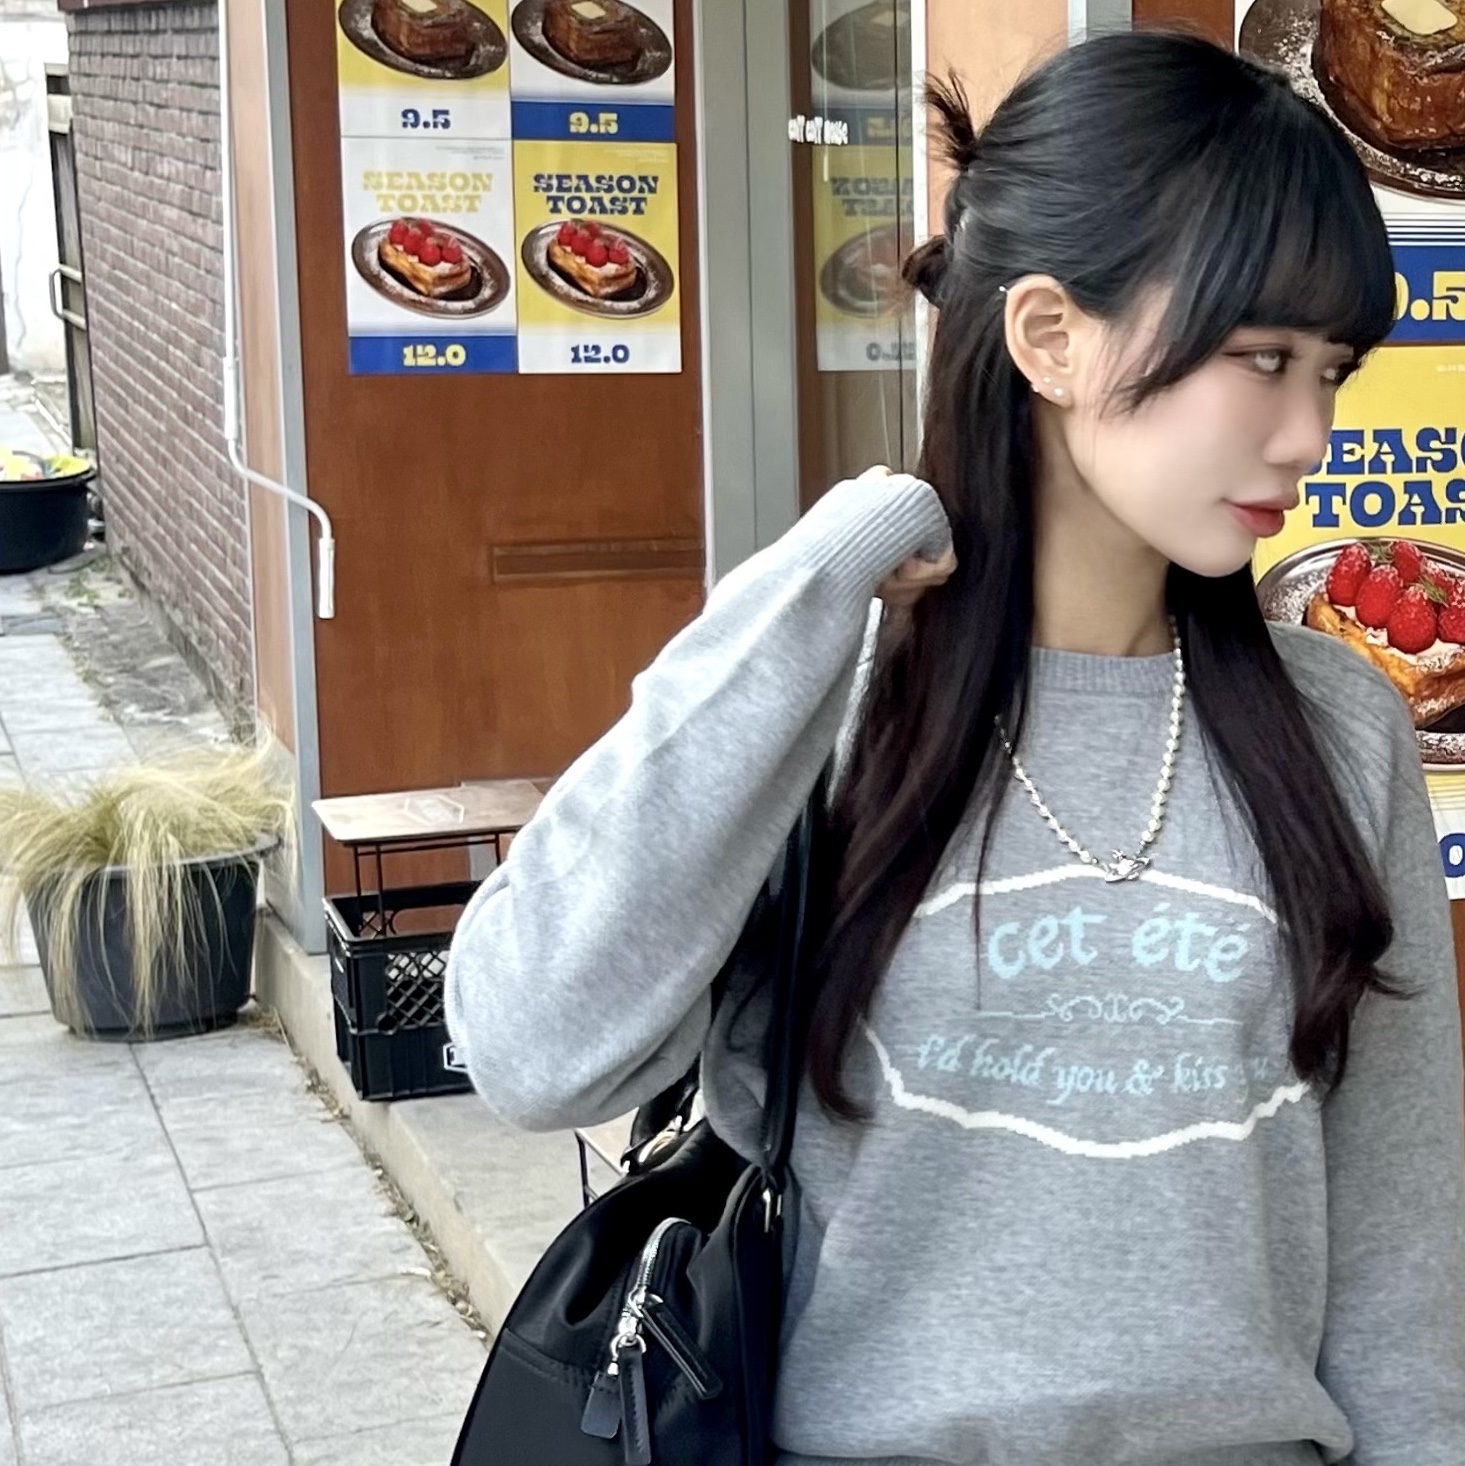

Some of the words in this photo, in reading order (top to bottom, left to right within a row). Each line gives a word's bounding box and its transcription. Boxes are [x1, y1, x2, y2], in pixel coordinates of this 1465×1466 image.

[401, 108, 451, 130] 9.5
[569, 111, 619, 134] 9.5
[363, 171, 493, 193] SEASON
[533, 174, 659, 195] SEASON
[376, 194, 482, 214] TOAST
[546, 196, 648, 216] TOAST
[403, 343, 467, 367] 12.0
[571, 344, 630, 364] 12.0
[987, 906, 1108, 979] cet
[1131, 902, 1251, 983] été
[970, 1038, 1057, 1087] hold
[1046, 1064, 1117, 1105] you
[1122, 1059, 1165, 1096] &
[1172, 1052, 1229, 1094] kiss
